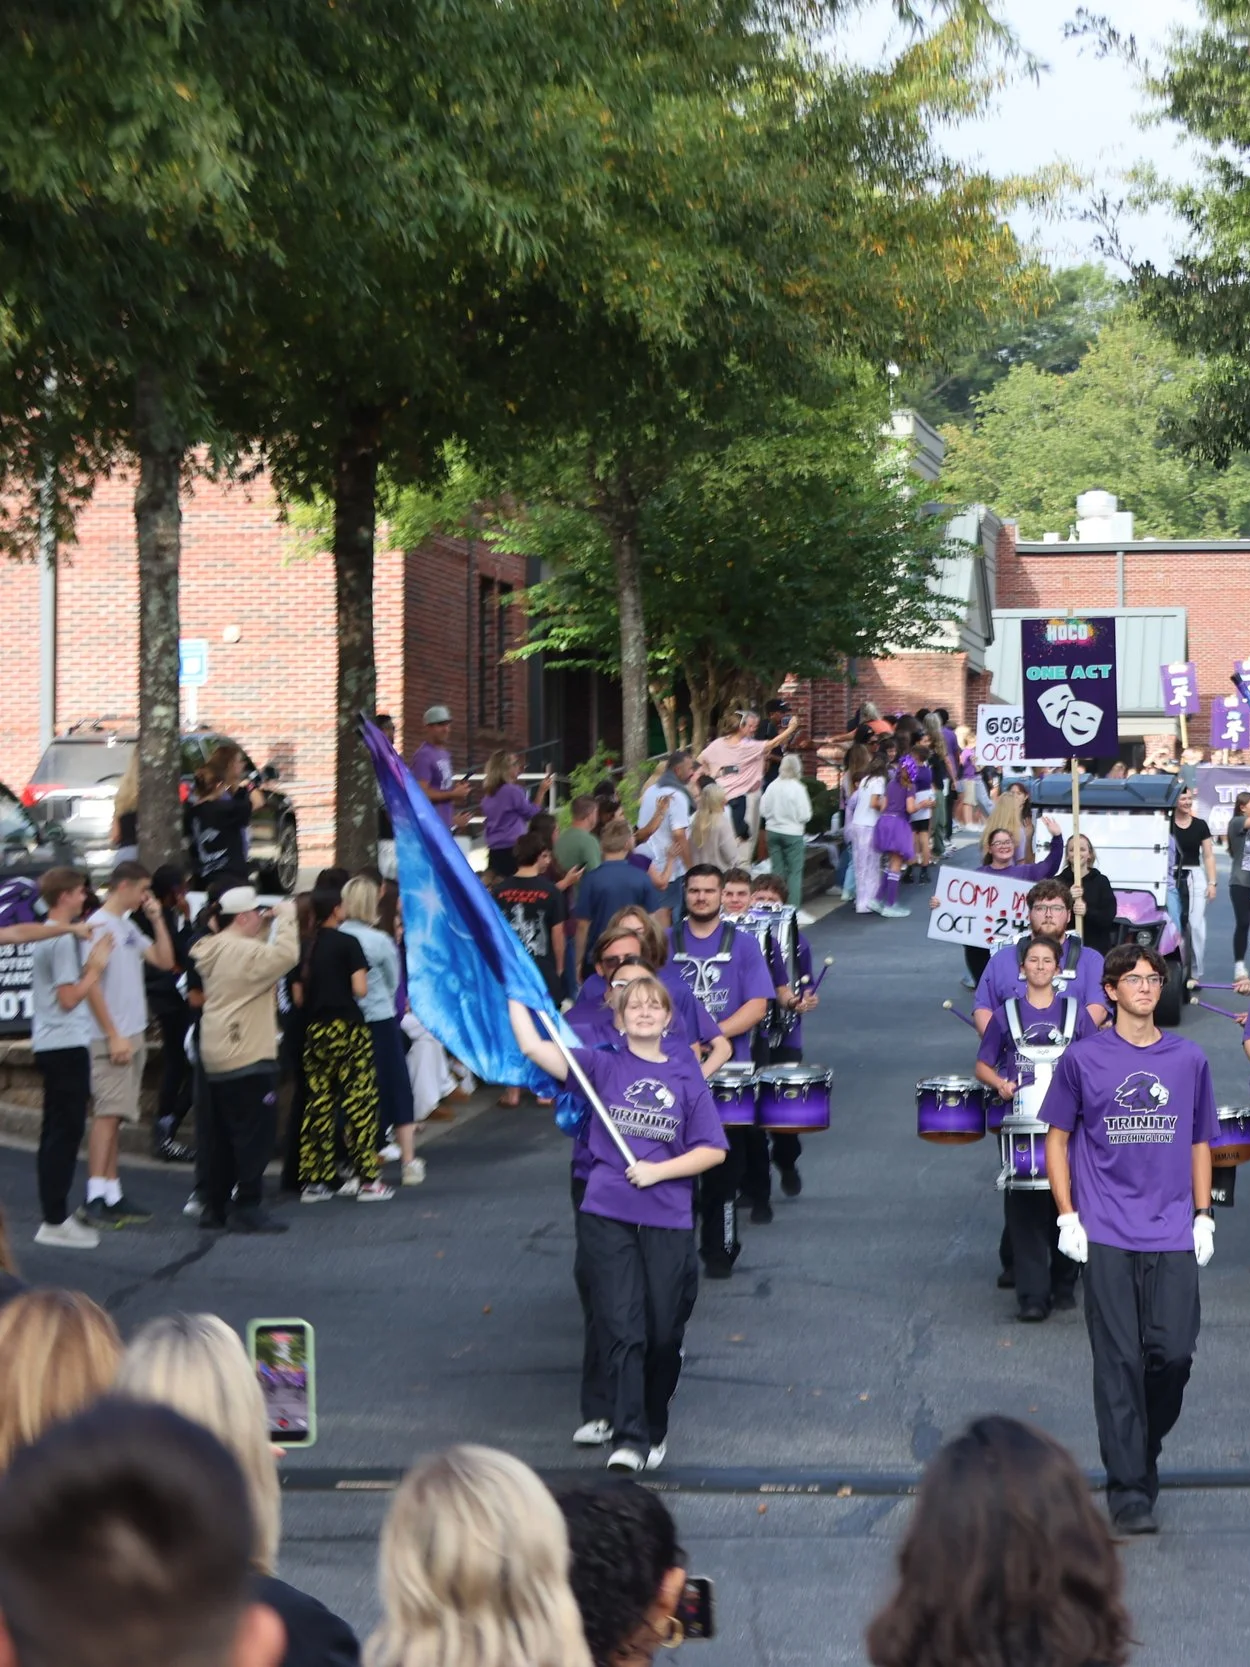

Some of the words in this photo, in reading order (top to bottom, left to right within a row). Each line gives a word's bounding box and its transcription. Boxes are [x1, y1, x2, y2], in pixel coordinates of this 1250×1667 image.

[1045, 624, 1088, 642] HOCO
[1026, 665, 1067, 680] ONE
[1071, 664, 1112, 679] ACT
[982, 743, 1018, 761] OCT
[947, 879, 999, 908] COMP
[937, 912, 976, 934] OCT
[609, 1105, 681, 1130] TRINITY
[1103, 1114, 1178, 1131] TRINITY
[1108, 1133, 1152, 1145] MARCHING
